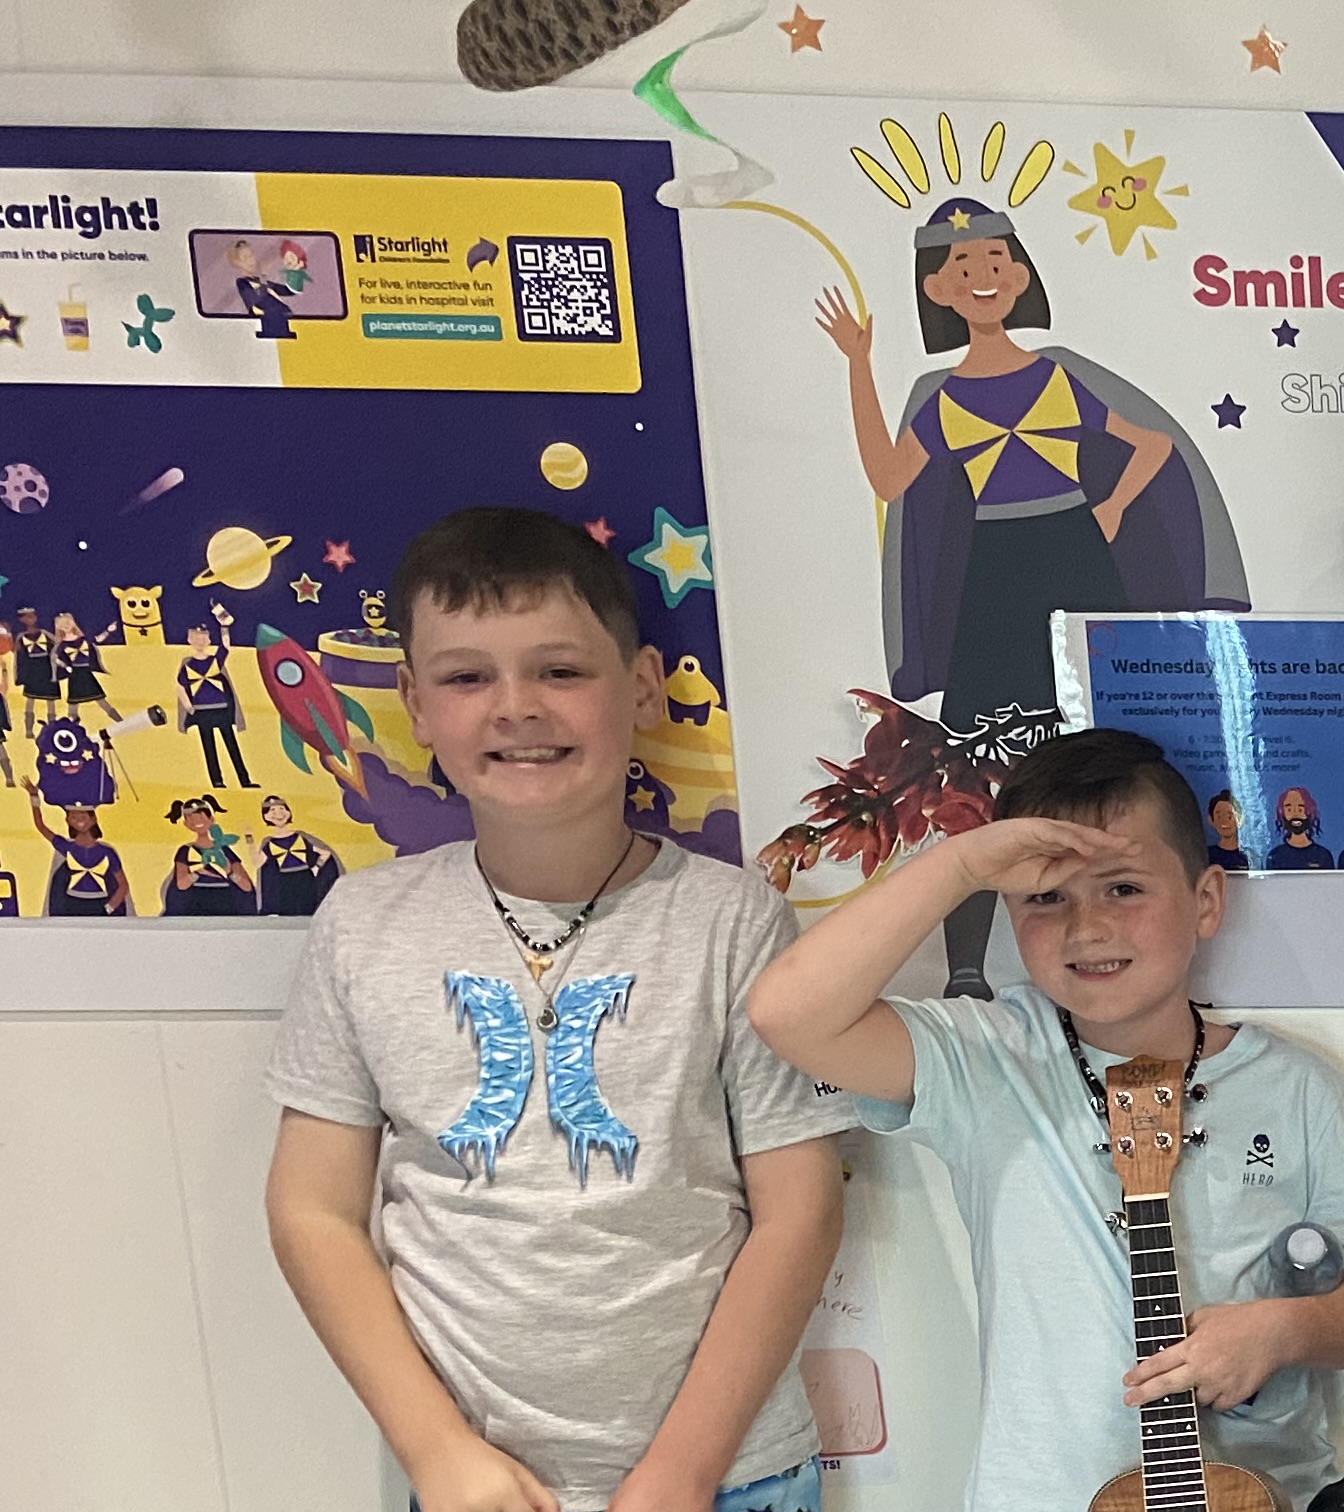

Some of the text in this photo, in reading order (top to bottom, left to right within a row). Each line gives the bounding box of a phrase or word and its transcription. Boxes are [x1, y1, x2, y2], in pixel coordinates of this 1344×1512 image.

[377, 237, 449, 257] Starlight
[21, 248, 34, 260] in
[36, 248, 58, 260] the
[61, 249, 106, 262] picture
[108, 250, 149, 262] below.
[358, 277, 378, 289] For
[406, 279, 470, 291] interactive
[473, 280, 493, 291] fun
[360, 293, 495, 307] for kids in hospital visit
[368, 319, 495, 334] planetstarlight.org.au
[1111, 658, 1215, 677] Wednesday
[1281, 661, 1311, 674] are
[1095, 691, 1105, 700] If
[1156, 692, 1169, 700] or
[1170, 692, 1196, 700] over
[1266, 691, 1308, 702] Express
[1310, 691, 1342, 701] Room
[1121, 706, 1180, 718] exclusively
[1182, 706, 1198, 716] for
[1262, 706, 1324, 718] Wednesday
